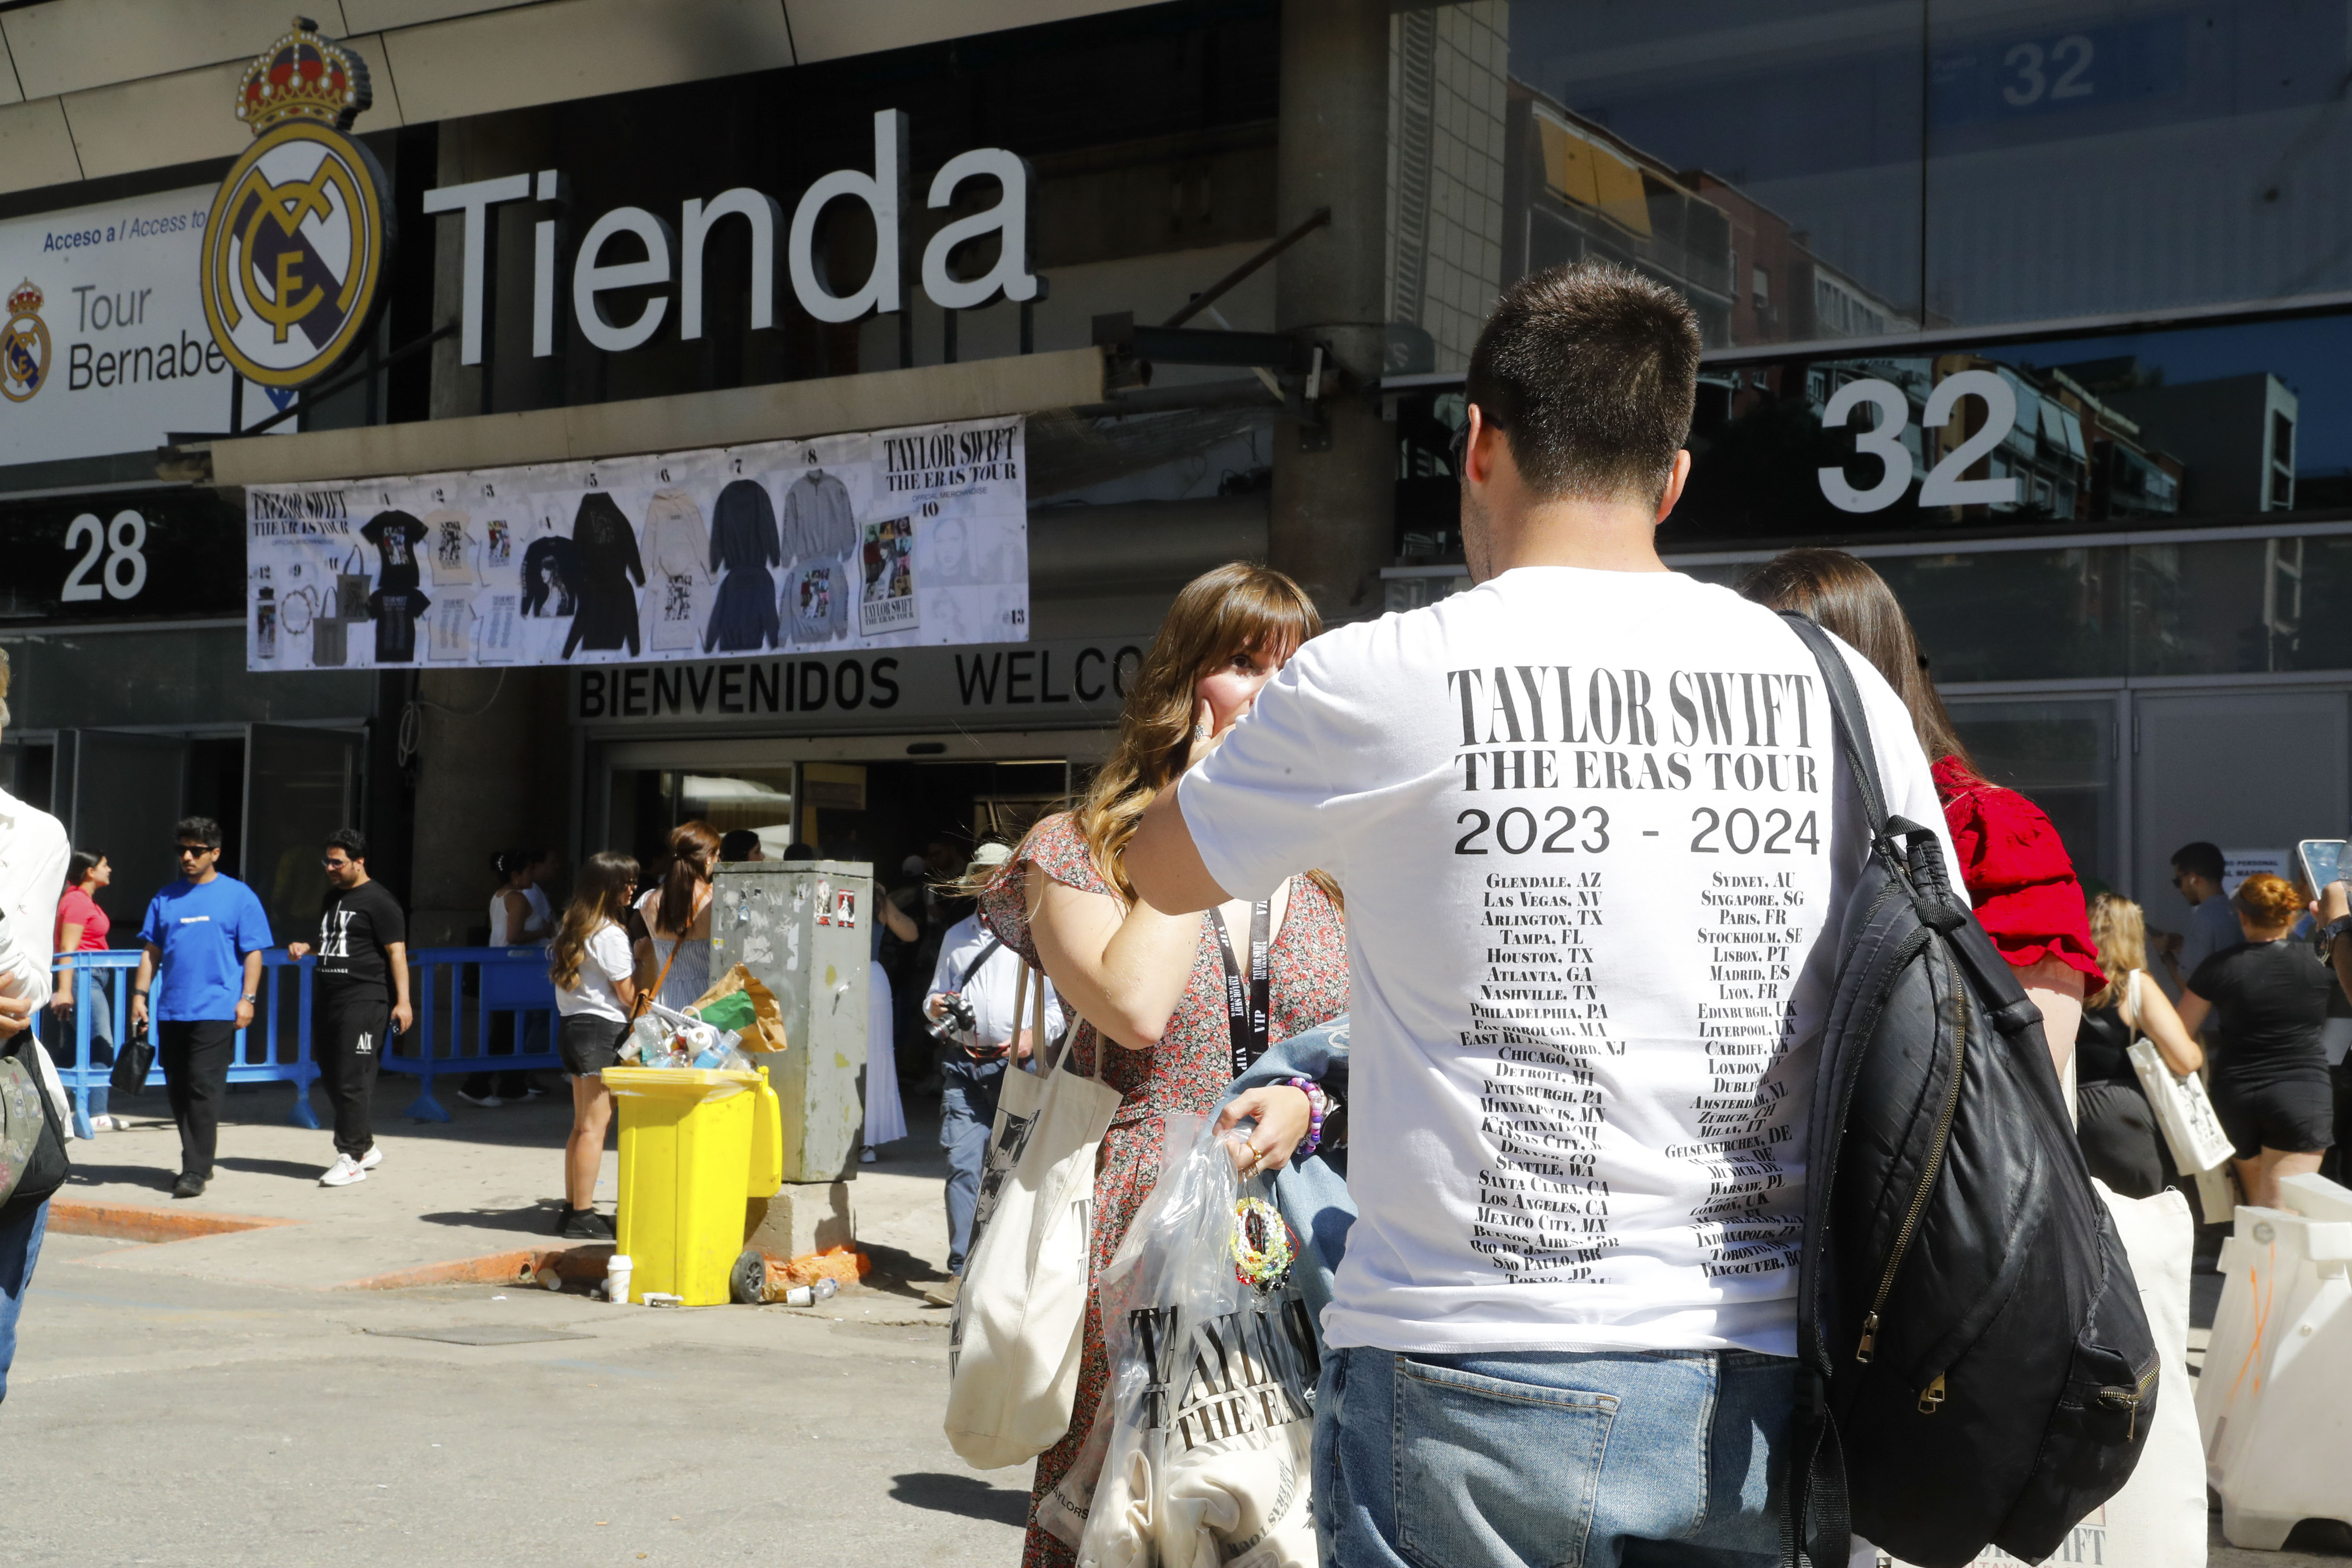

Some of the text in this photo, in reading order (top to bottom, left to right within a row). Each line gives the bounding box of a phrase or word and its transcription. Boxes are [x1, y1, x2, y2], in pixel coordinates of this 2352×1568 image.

[2004, 34, 2094, 106] 32
[44, 229, 101, 252] Acceso
[106, 227, 115, 242] a
[129, 216, 186, 239] Access
[192, 209, 206, 230] to
[423, 107, 1041, 366] Tienda
[72, 285, 152, 332] Tour
[69, 330, 225, 390] Bernabe
[884, 426, 1017, 473] TAYLOR SWIFT
[1818, 370, 2017, 513] 32
[886, 463, 1017, 492] THE ERAS TOUR
[912, 487, 988, 502] OFFICIAL MERCHANDISE
[252, 490, 348, 520] TAYLOR SWIFT
[253, 520, 349, 536] THE ERAS TOUR
[61, 509, 147, 602] 28
[863, 601, 890, 618] TAYLOR
[579, 644, 1146, 717] BIENVENIDOS WELCO
[1447, 665, 1814, 749] TAYLOR SWIFT
[1455, 750, 1819, 793] THE ERAS TOUR
[1454, 806, 1610, 856] 2023
[1690, 807, 1820, 856] 2024
[1486, 872, 1601, 890] GLENDALE, AZ
[1712, 872, 1796, 889] SYDNEY, AU
[1483, 891, 1603, 908] LAS VEGAS, NV
[1701, 890, 1805, 908] SINGAPORE, SG
[1481, 910, 1603, 927] ARLINGTON, TX
[1719, 909, 1788, 927] PARIS, FR
[1218, 926, 1230, 947] VIP
[1500, 929, 1584, 946] TAMPA, FL
[1697, 928, 1803, 945] STOCKHOLM, SE
[1253, 941, 1263, 980] TAYLOR SWIFT
[1487, 948, 1594, 965] HOUSTON, TX
[1712, 946, 1789, 964] LISBON, PT
[1487, 966, 1592, 983] ATLANTA, GA
[1709, 965, 1790, 982] MADRID, ES
[1231, 975, 1244, 1017] TAYLOR SWIFT
[1480, 985, 1598, 1001] NASHVILLE, TN
[1719, 983, 1778, 1001] LYON, FR
[1470, 1003, 1608, 1021] PHILADELPHIA, PA
[1697, 1000, 1797, 1019] EDINBURGH, UK
[1254, 1009, 1266, 1033] VIP
[1579, 1022, 1607, 1037] MA
[1699, 1019, 1797, 1037] LIVERPOOL, UK
[1460, 1031, 1626, 1056] EAST NJ
[1705, 1038, 1789, 1056] CARDIFF, UK
[1235, 1047, 1247, 1071] VIP
[1498, 1047, 1593, 1070] CHICAGO, IL
[1708, 1058, 1764, 1075] LONDON,
[1496, 1063, 1595, 1086] DETROIT, MI
[1483, 1080, 1602, 1104] PITTSBURGH, PA
[1689, 1081, 1788, 1109] AMSTERDAM, NL
[1579, 1106, 1606, 1123] MN
[1697, 1103, 1776, 1123] ZÜRICH, CH
[1697, 1119, 1766, 1138] MILAN, IT
[1543, 1134, 1585, 1152] CITY,
[1665, 1125, 1793, 1159] GELSENKIRCHEN, DE
[1569, 1154, 1596, 1165] CO
[1751, 1147, 1776, 1162] DE
[1496, 1154, 1594, 1178] SEATTLE, WA
[1707, 1163, 1783, 1179] MUNICH, DE
[1479, 1170, 1610, 1197] SANTA CLARA, CA
[1767, 1174, 1786, 1189] PL
[1480, 1188, 1609, 1216] LOS ANGELES, CA
[1689, 1200, 1741, 1216] LONDON,
[1746, 1191, 1770, 1207] UK
[1475, 1206, 1609, 1234] MEXICO CITY, MX
[1470, 1240, 1497, 1254] RIO
[1502, 1244, 1520, 1254] DE
[1710, 1244, 1772, 1261] TORONTO,
[1524, 1255, 1575, 1271] PAULO,
[1577, 1248, 1603, 1263] BR
[1700, 1258, 1785, 1278] VANCOUVER,
[1568, 1267, 1592, 1280] JP
